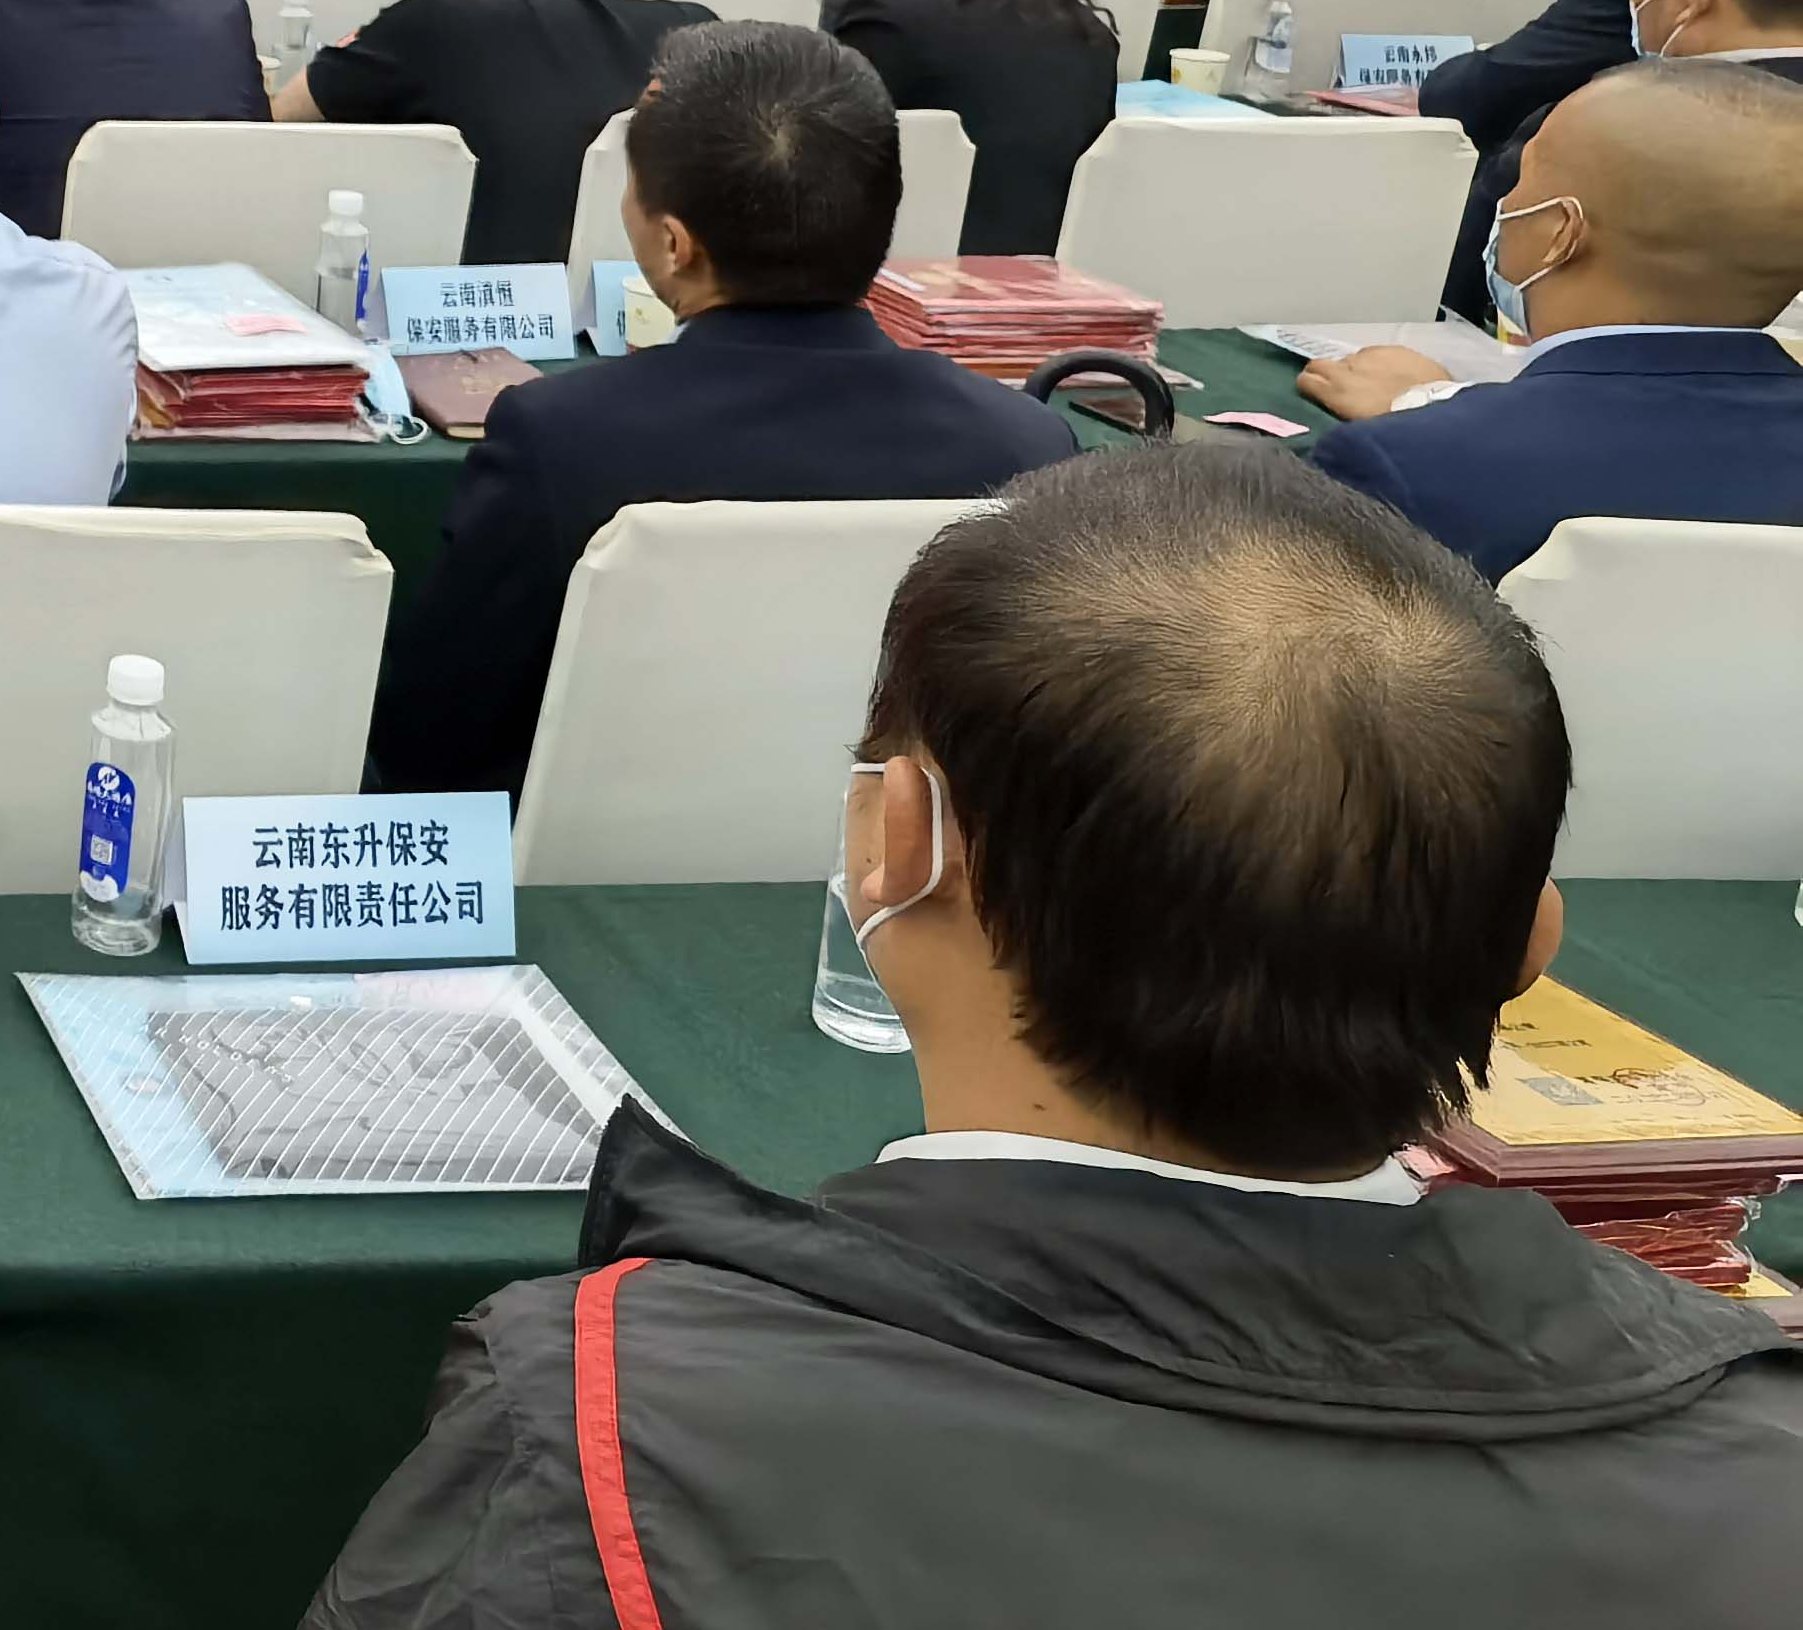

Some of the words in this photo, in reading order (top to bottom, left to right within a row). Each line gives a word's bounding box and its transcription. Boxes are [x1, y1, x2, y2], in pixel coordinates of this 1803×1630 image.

[407, 313, 555, 345] 保安服务有限公司
[252, 819, 449, 869] 云南东升保安
[220, 880, 484, 931] 服务有限责任公司
